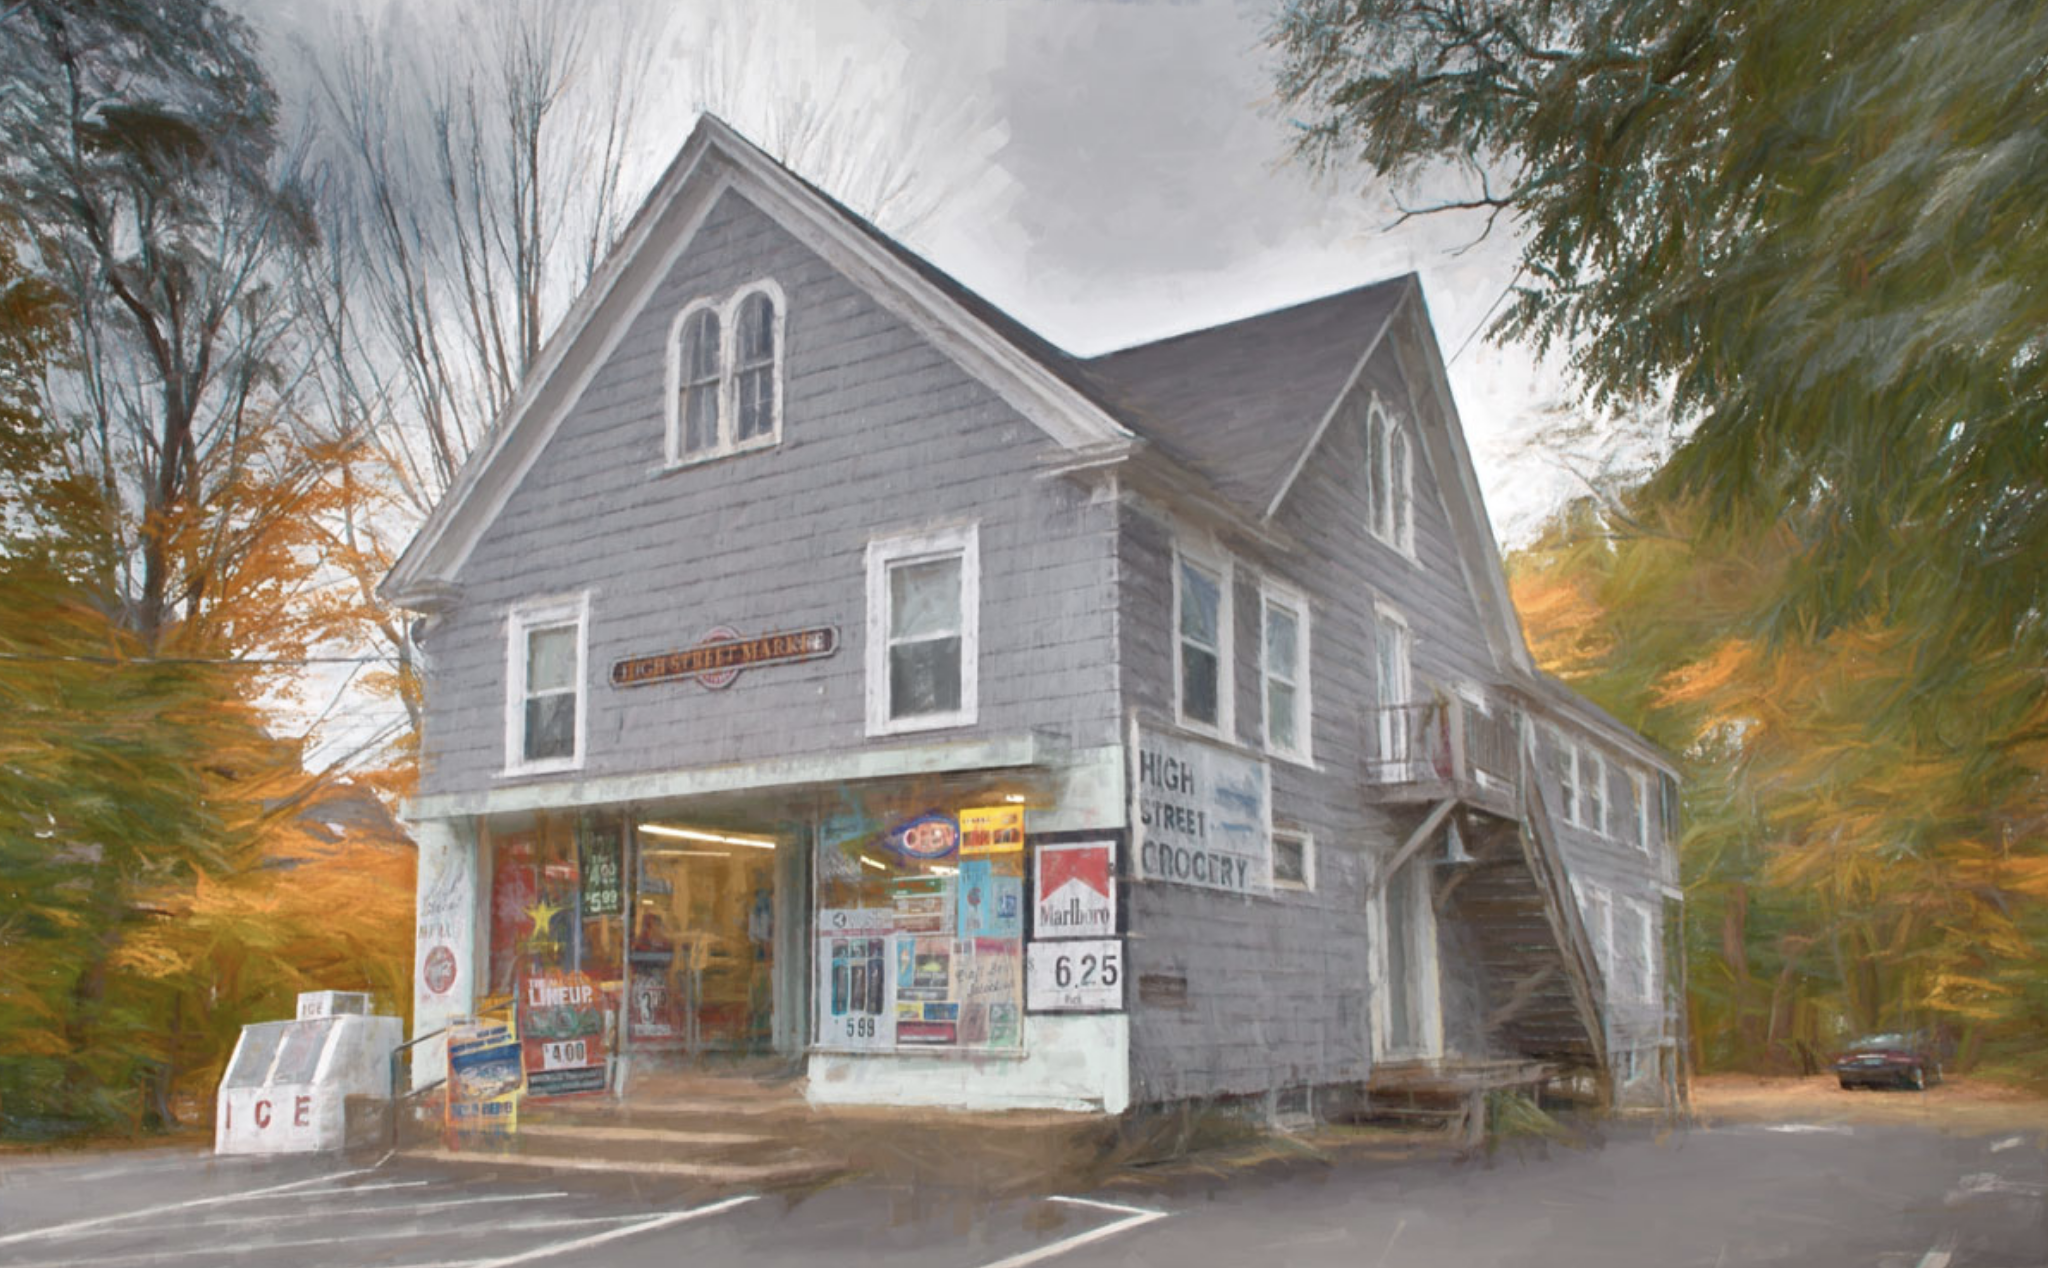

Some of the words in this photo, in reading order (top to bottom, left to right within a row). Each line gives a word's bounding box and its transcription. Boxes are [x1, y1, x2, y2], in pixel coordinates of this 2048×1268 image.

[1140, 750, 1195, 796] HIGH
[1141, 798, 1206, 838] STREET
[1041, 898, 1111, 927] Marlboro
[1056, 953, 1118, 989] 6.25
[225, 1096, 311, 1130] ICE
